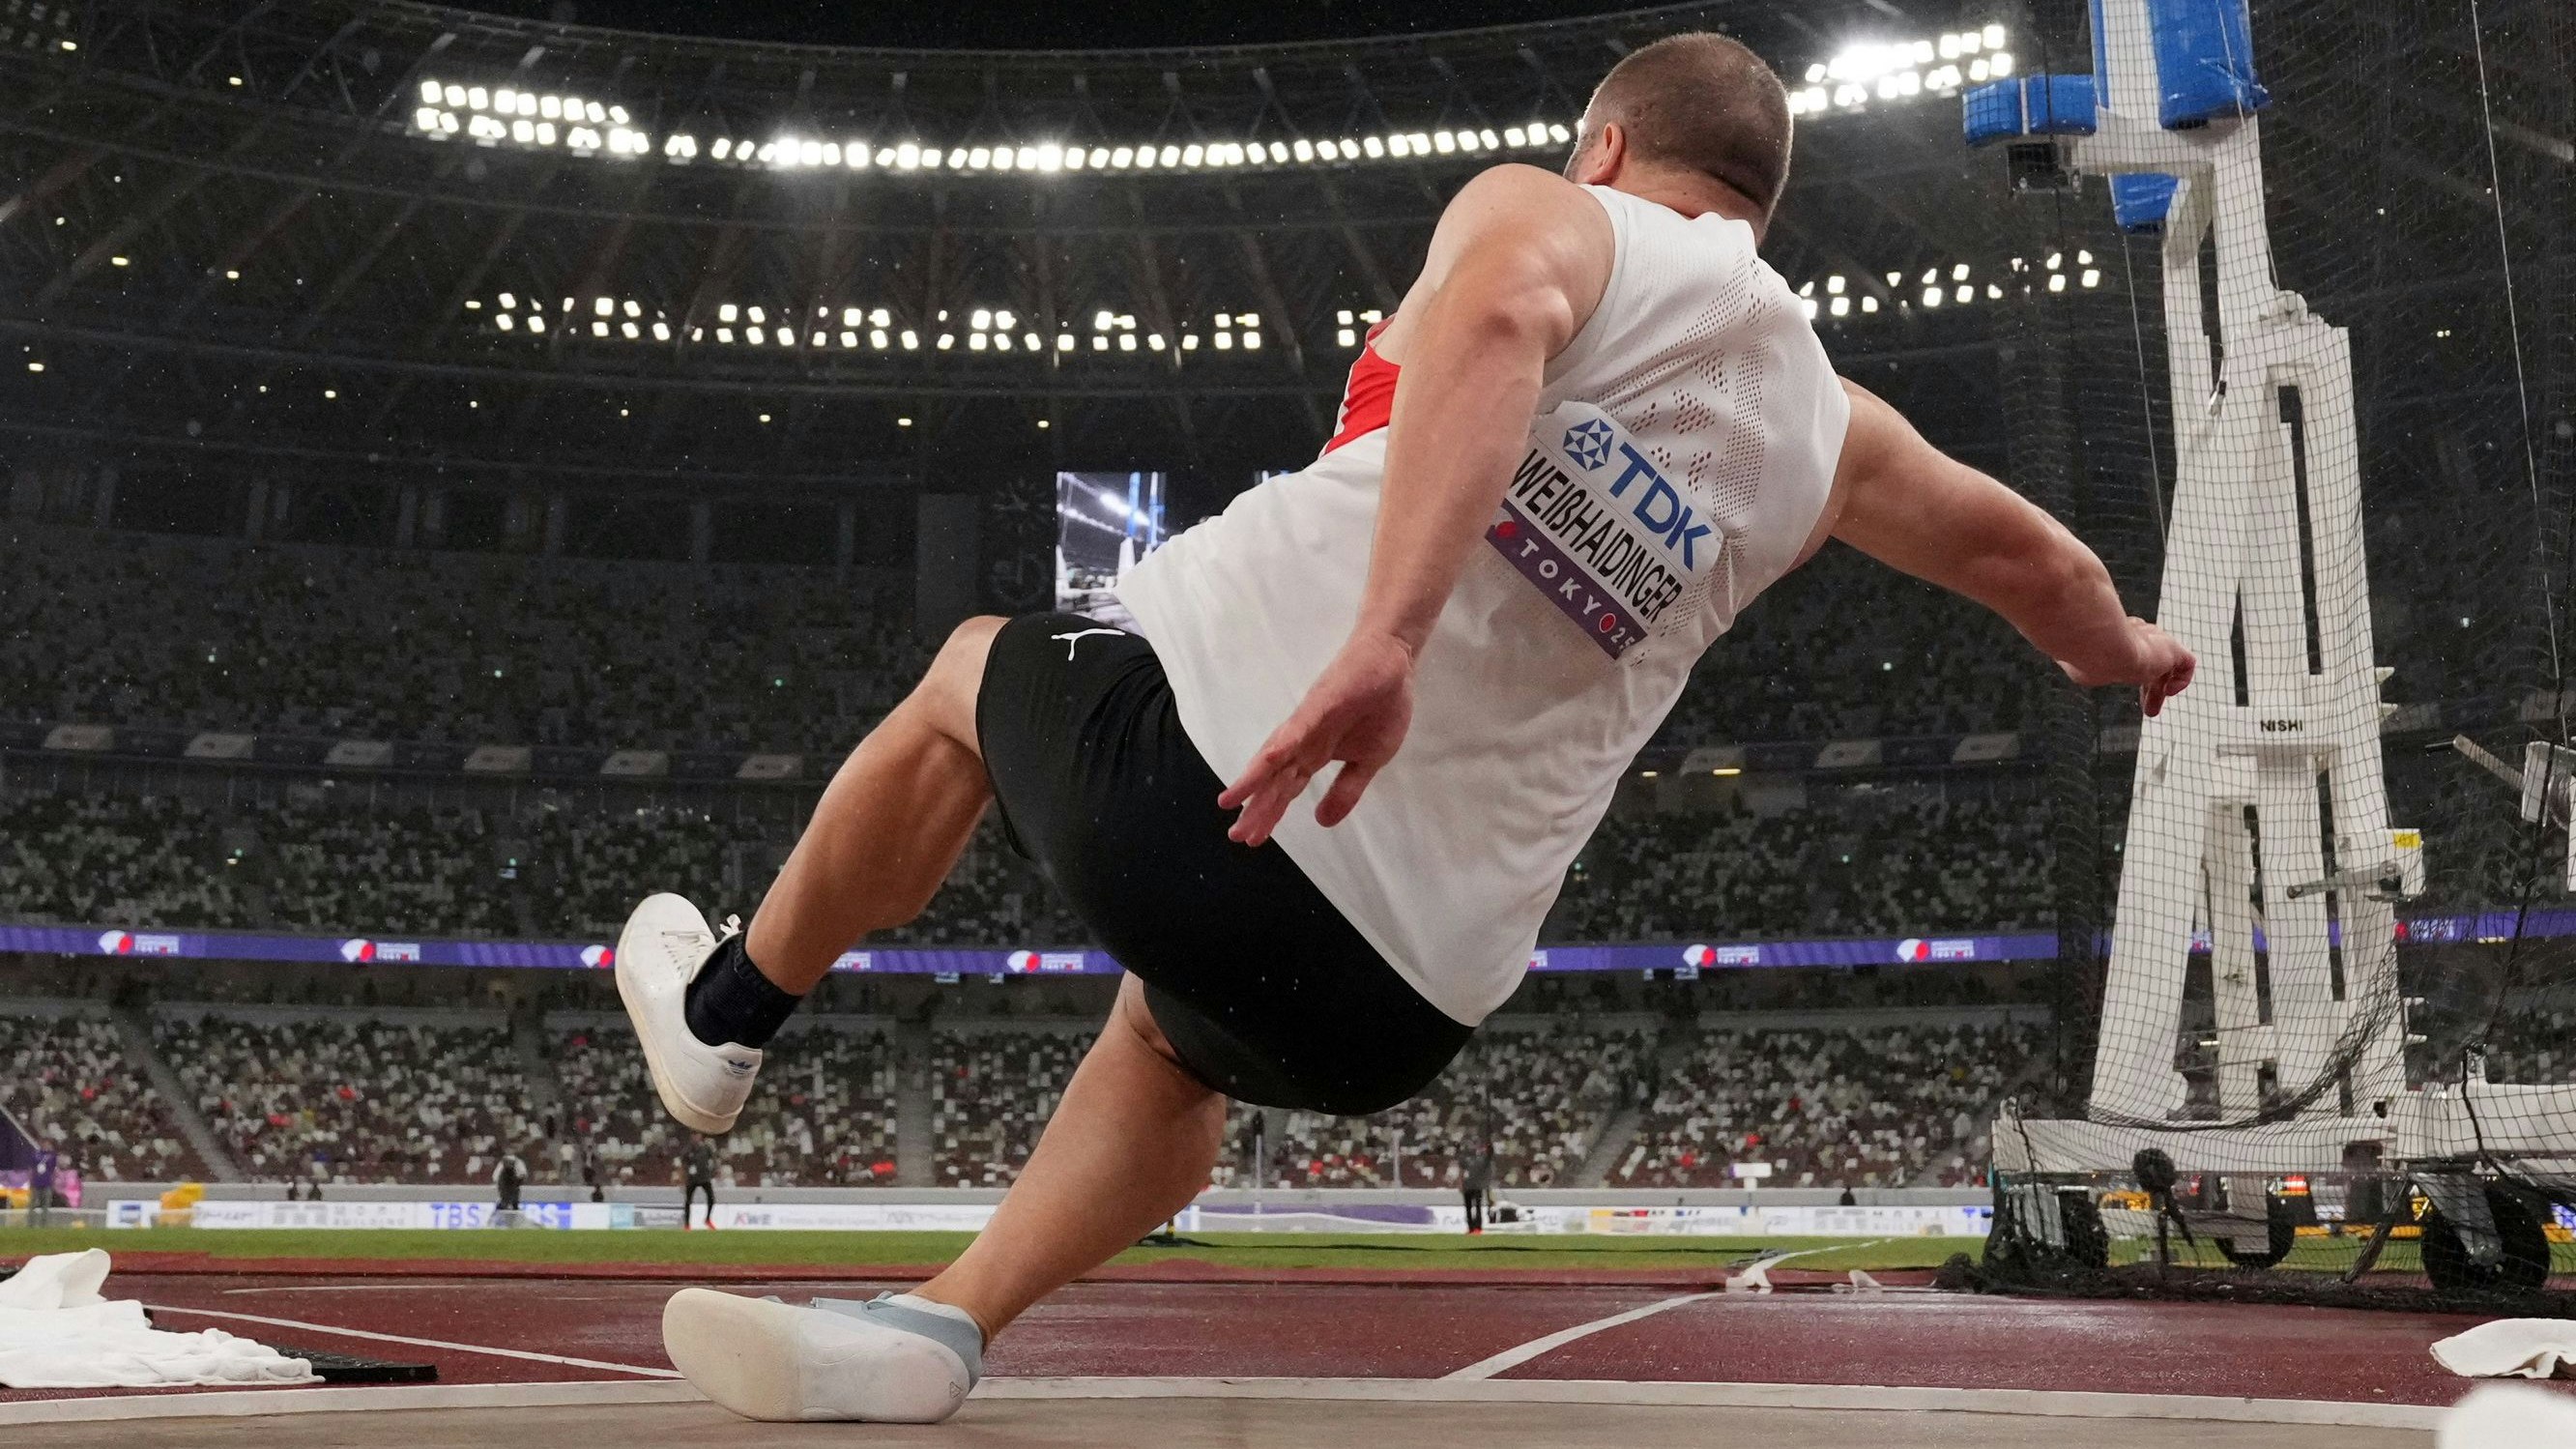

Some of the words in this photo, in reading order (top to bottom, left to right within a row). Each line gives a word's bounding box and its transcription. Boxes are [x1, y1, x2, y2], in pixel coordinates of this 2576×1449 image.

[1608, 441, 1712, 572] TDK
[2260, 719, 2303, 733] NISHI
[430, 1203, 480, 1230] TBS
